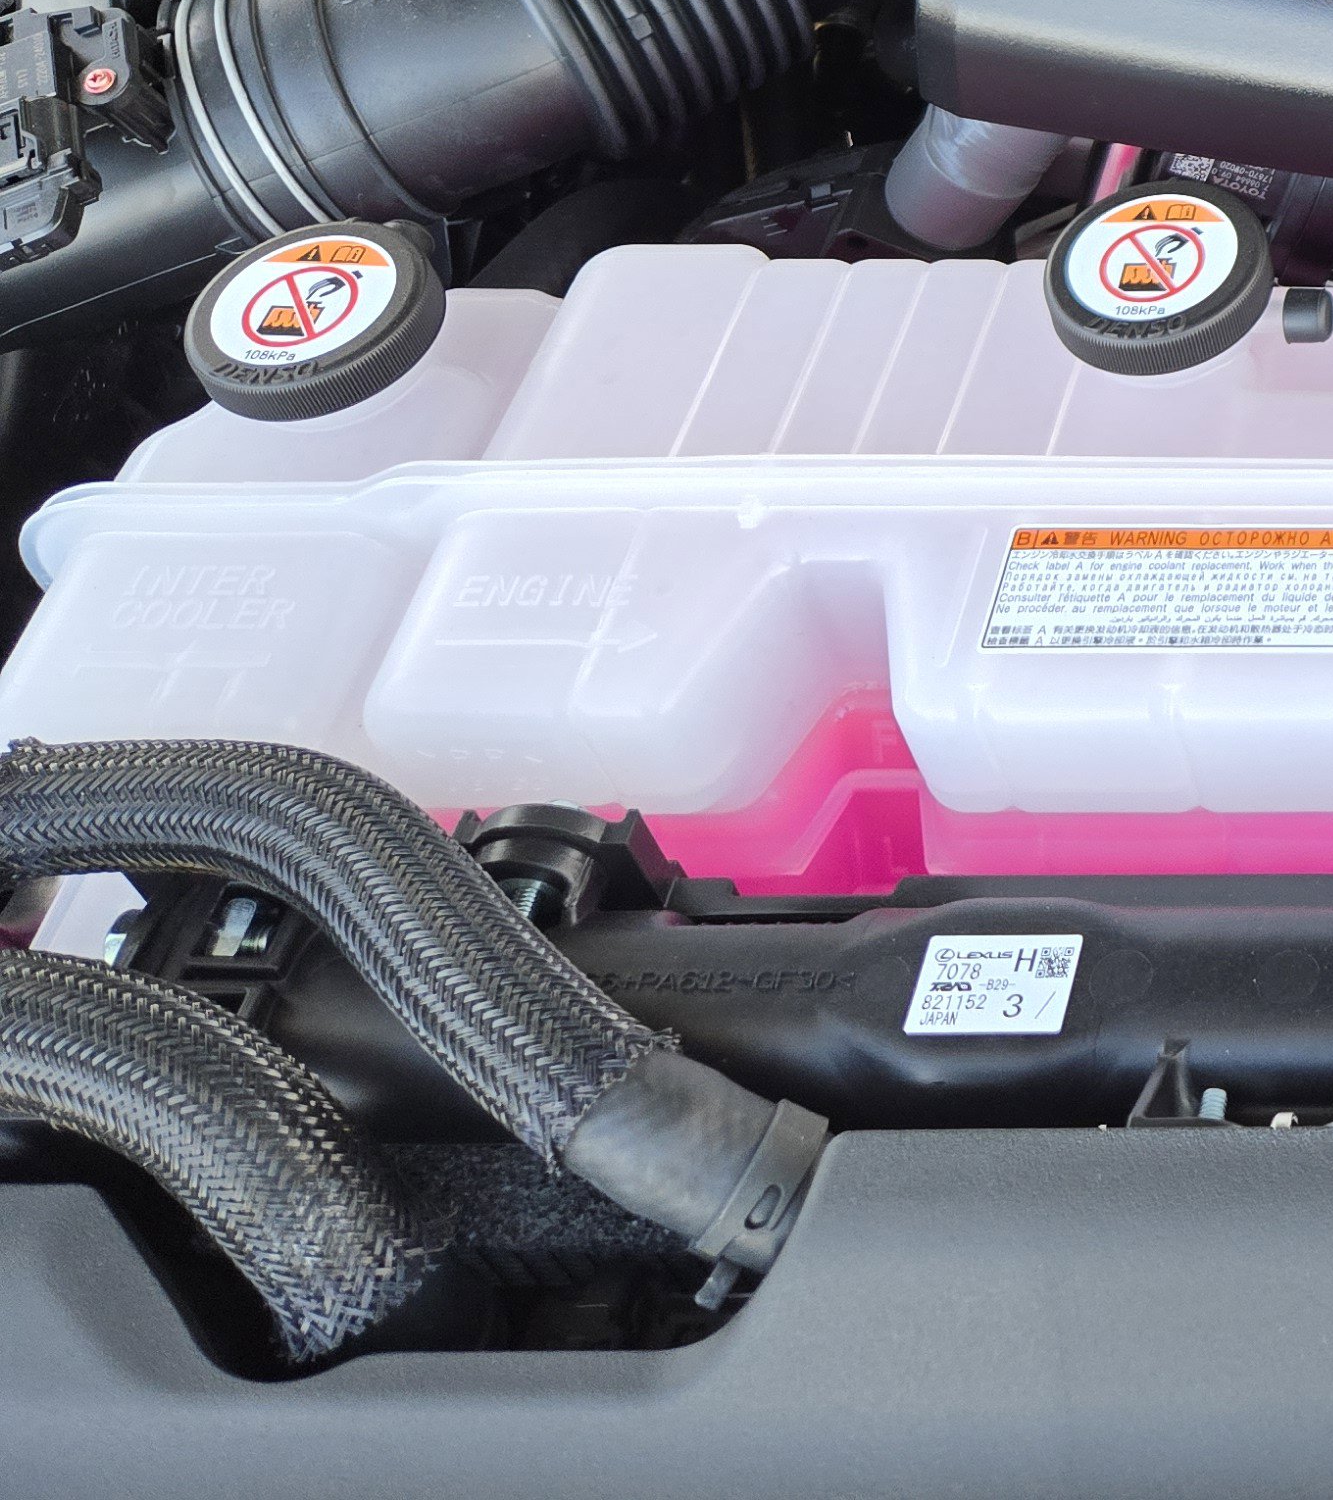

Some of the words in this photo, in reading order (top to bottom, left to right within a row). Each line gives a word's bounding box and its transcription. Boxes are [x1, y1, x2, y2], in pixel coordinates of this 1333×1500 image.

[1212, 175, 1266, 200] TOYOTA
[1115, 305, 1166, 316] 108kPa
[1084, 314, 1187, 339] DENSO
[244, 350, 297, 361] 108kPa
[1017, 532, 1031, 546] B
[1110, 531, 1188, 546] WARNING
[1200, 531, 1310, 546] ОСТОРОЖНО
[1008, 562, 1039, 571] Check
[1046, 562, 1070, 571] label
[1075, 562, 1083, 570] A
[1090, 562, 1104, 570] for
[1110, 562, 1142, 571] engine
[1148, 562, 1185, 570] coolant
[1191, 562, 1252, 572] replacement.
[1259, 562, 1284, 571] Work
[1291, 562, 1316, 570] when
[123, 565, 277, 597] INTER
[453, 573, 640, 608] ENGINE
[999, 593, 1051, 602] Consulter
[1058, 592, 1110, 603] l'étiquette
[1116, 593, 1125, 602] A
[1132, 594, 1158, 603] pour
[1164, 592, 1174, 601] le
[1180, 592, 1254, 603] remplacement
[1261, 592, 1275, 601] du
[1282, 592, 1317, 603] liquide
[110, 599, 297, 631] COOLER
[996, 604, 1010, 613] Ne
[1071, 605, 1086, 613] au
[1092, 604, 1167, 614] remplacement
[1174, 605, 1194, 614] que
[1200, 603, 1240, 614] lorsque
[1248, 603, 1257, 612] le
[1263, 604, 1300, 613] moteur
[1307, 604, 1317, 612] et
[1325, 603, 1333, 612] le
[956, 951, 1013, 959] LEXUS
[1014, 948, 1038, 972] H
[936, 963, 982, 980] 7078
[921, 994, 987, 1010] 821152
[1002, 993, 1024, 1018] 3
[919, 1011, 959, 1026] JAPAN
